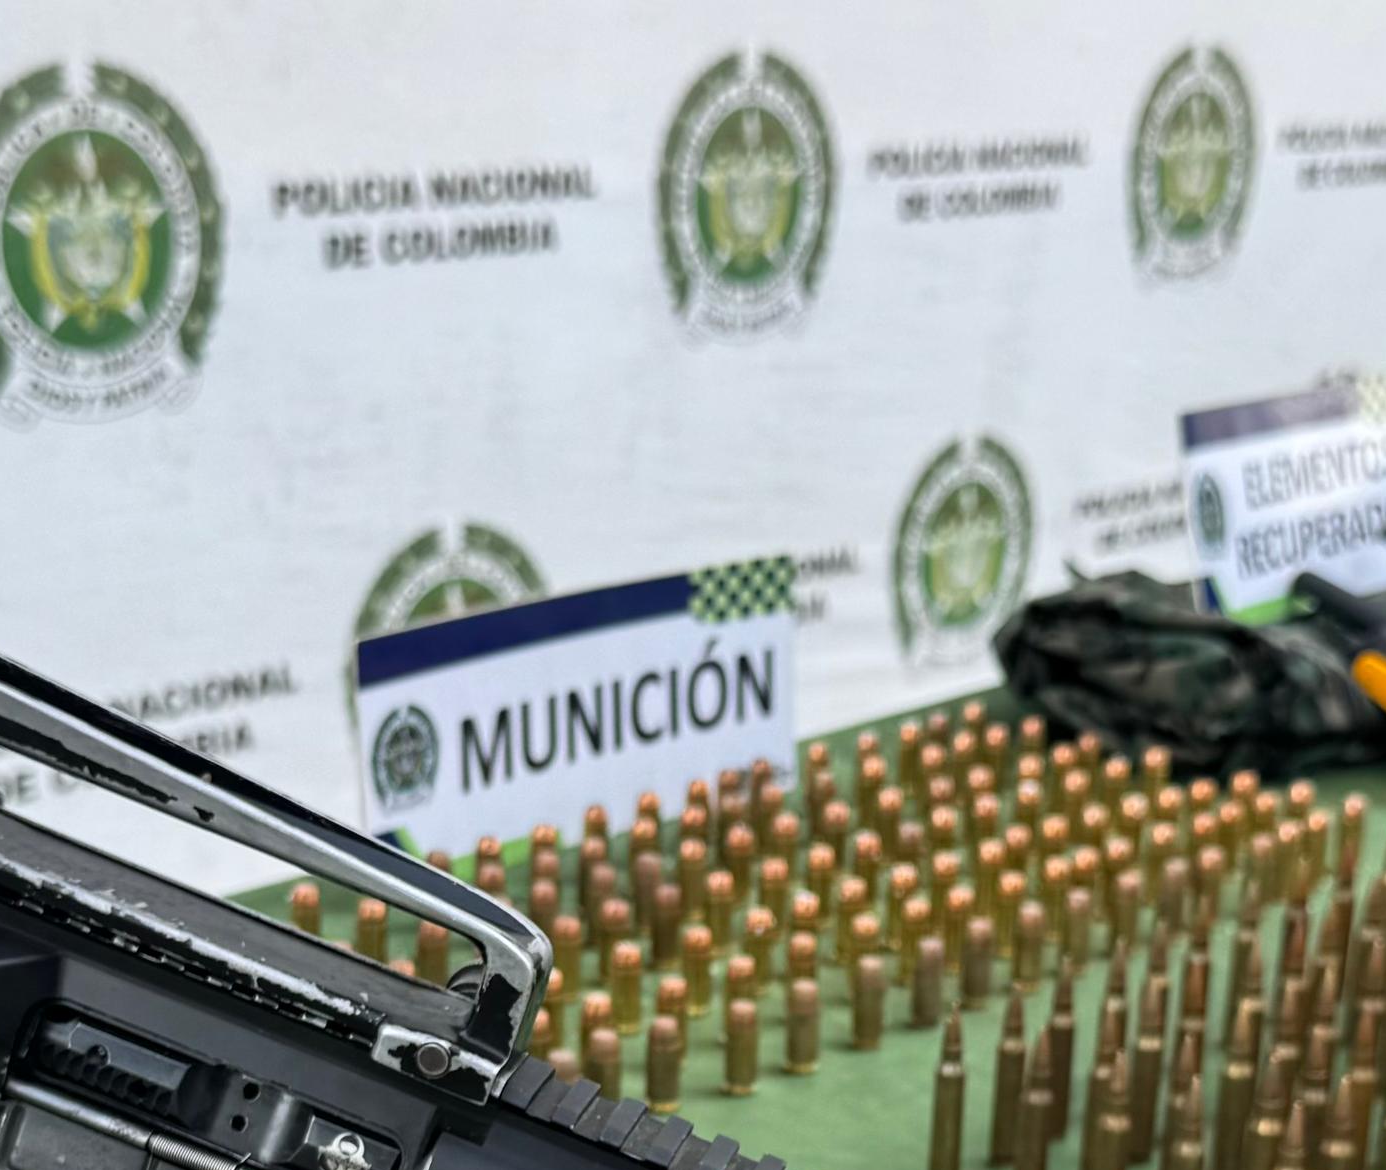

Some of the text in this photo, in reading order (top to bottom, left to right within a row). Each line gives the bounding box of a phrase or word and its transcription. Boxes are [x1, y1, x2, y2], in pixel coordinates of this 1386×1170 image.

[270, 164, 598, 221] POLICIA NACIONAL
[322, 217, 558, 270] DE COLOMBIA
[461, 636, 774, 793] MUNICIÓN
